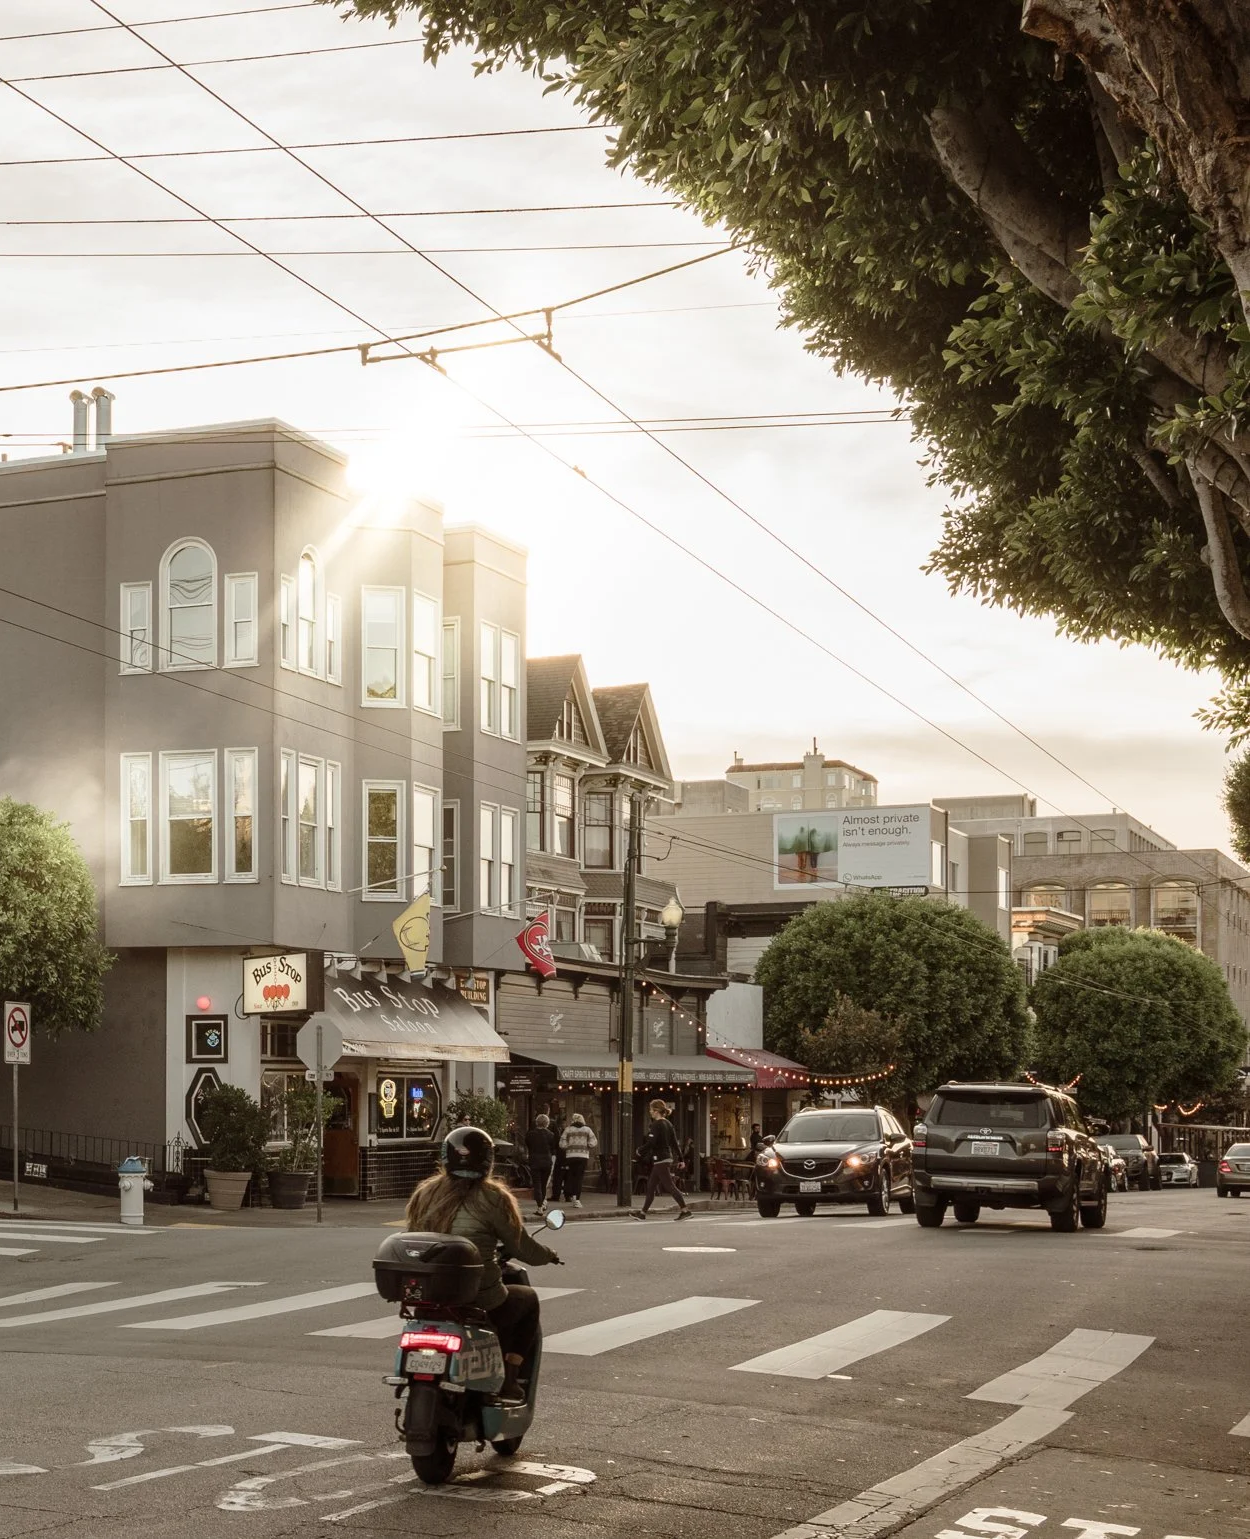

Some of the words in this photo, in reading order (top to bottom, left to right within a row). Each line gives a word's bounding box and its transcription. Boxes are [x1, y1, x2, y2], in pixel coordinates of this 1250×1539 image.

[843, 815, 880, 825] Almost
[883, 814, 920, 825] private
[843, 827, 866, 837] isn't
[868, 825, 911, 837] enough.
[333, 987, 381, 1013] Bus
[380, 985, 440, 1019] Stop
[380, 1014, 438, 1034] Saloon
